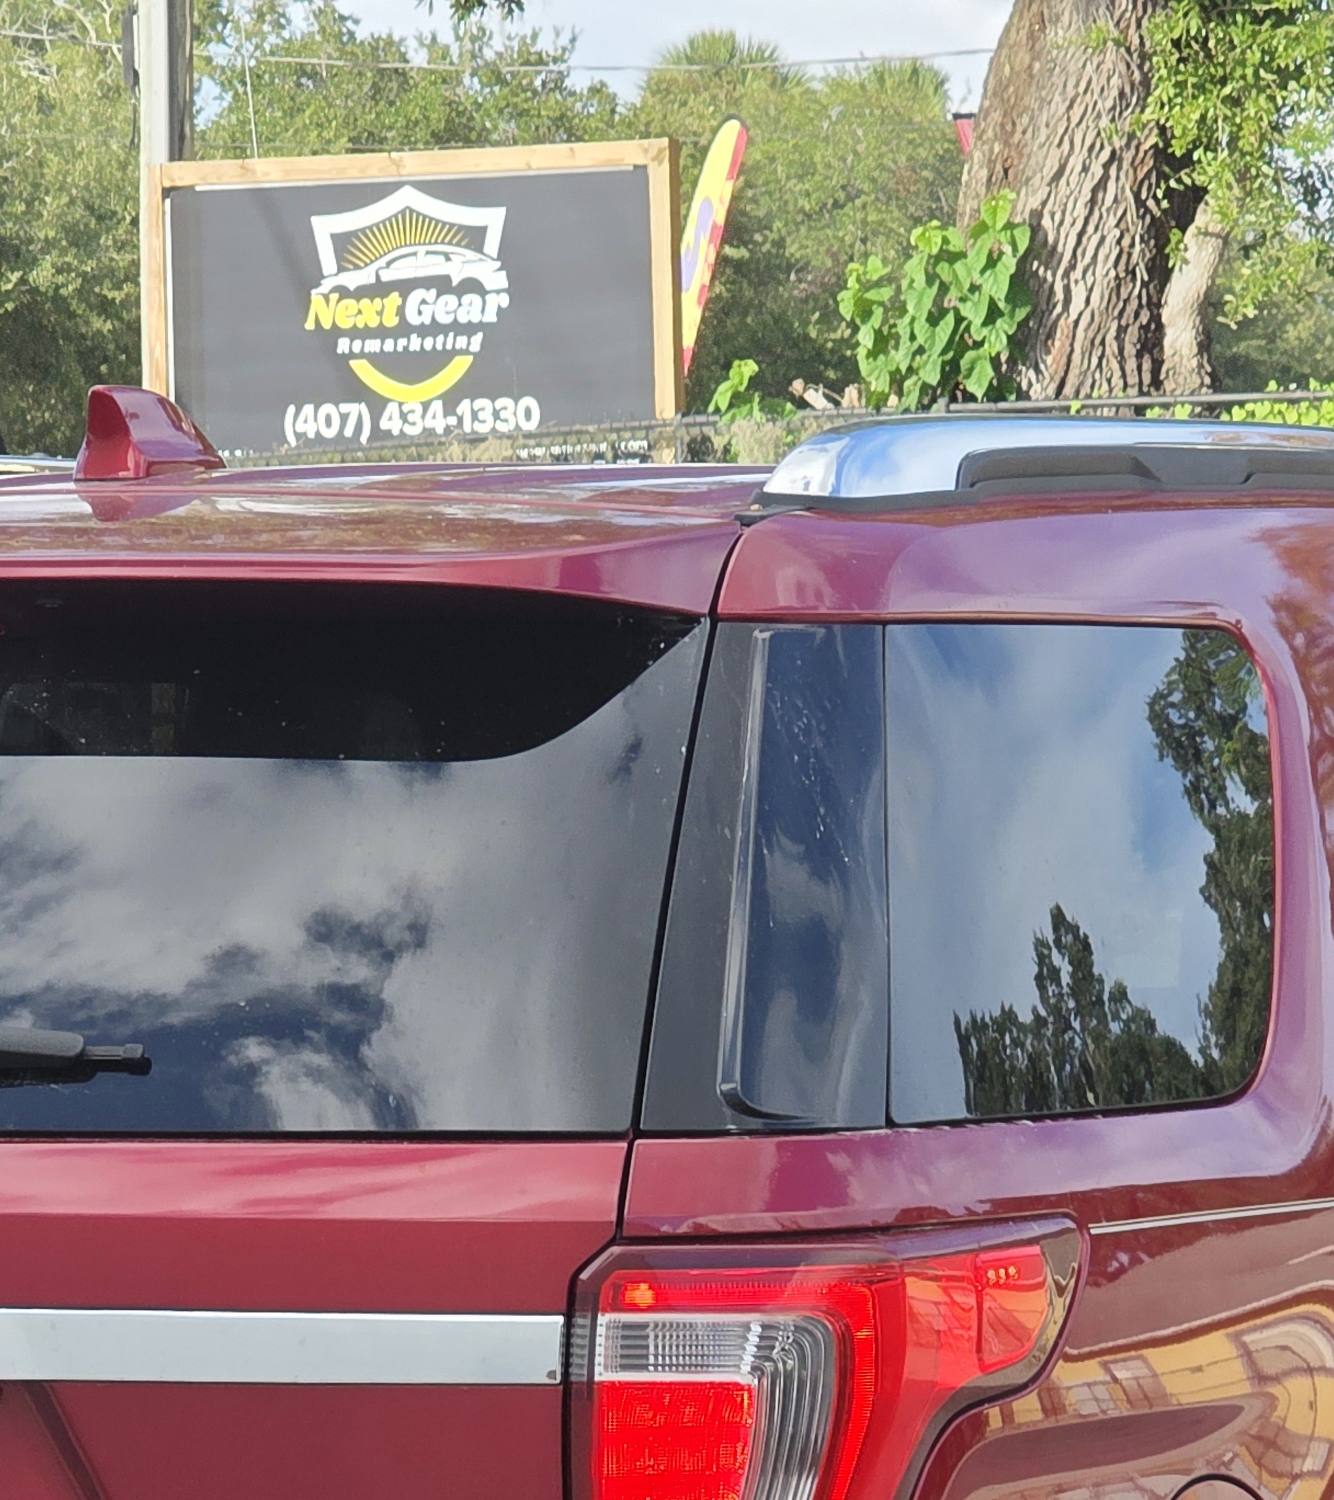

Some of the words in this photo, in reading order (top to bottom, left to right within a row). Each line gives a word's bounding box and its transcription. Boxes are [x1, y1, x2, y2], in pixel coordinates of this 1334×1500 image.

[304, 291, 403, 330] Next
[404, 287, 510, 326] Gear
[336, 331, 484, 354] Remarketing
[284, 402, 371, 447] (407)
[379, 397, 541, 437] 434-1330
